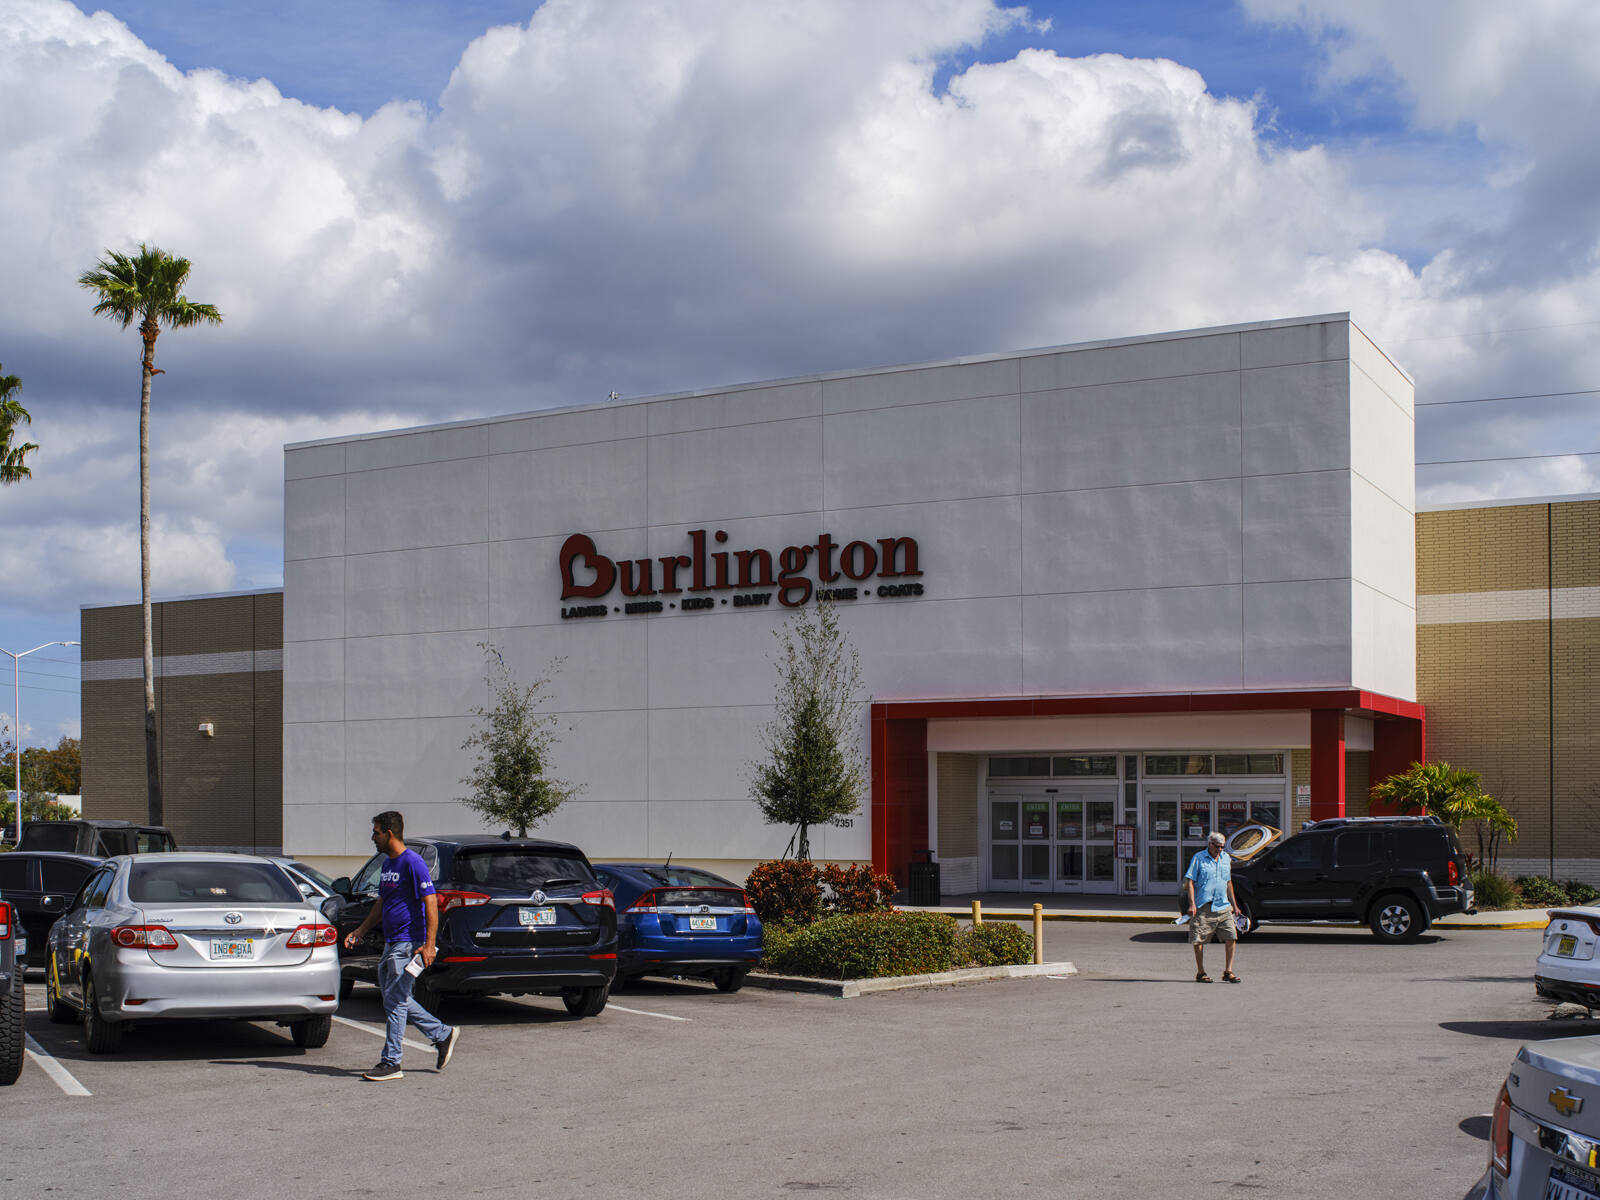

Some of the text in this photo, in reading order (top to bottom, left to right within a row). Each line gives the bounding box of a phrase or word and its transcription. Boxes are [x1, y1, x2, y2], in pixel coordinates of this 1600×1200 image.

[560, 530, 923, 607] Burlington
[561, 605, 608, 619] LADIES
[681, 597, 714, 611] KIDS
[733, 592, 772, 607] BABY
[877, 583, 924, 597] COATS
[835, 818, 854, 828] 7351
